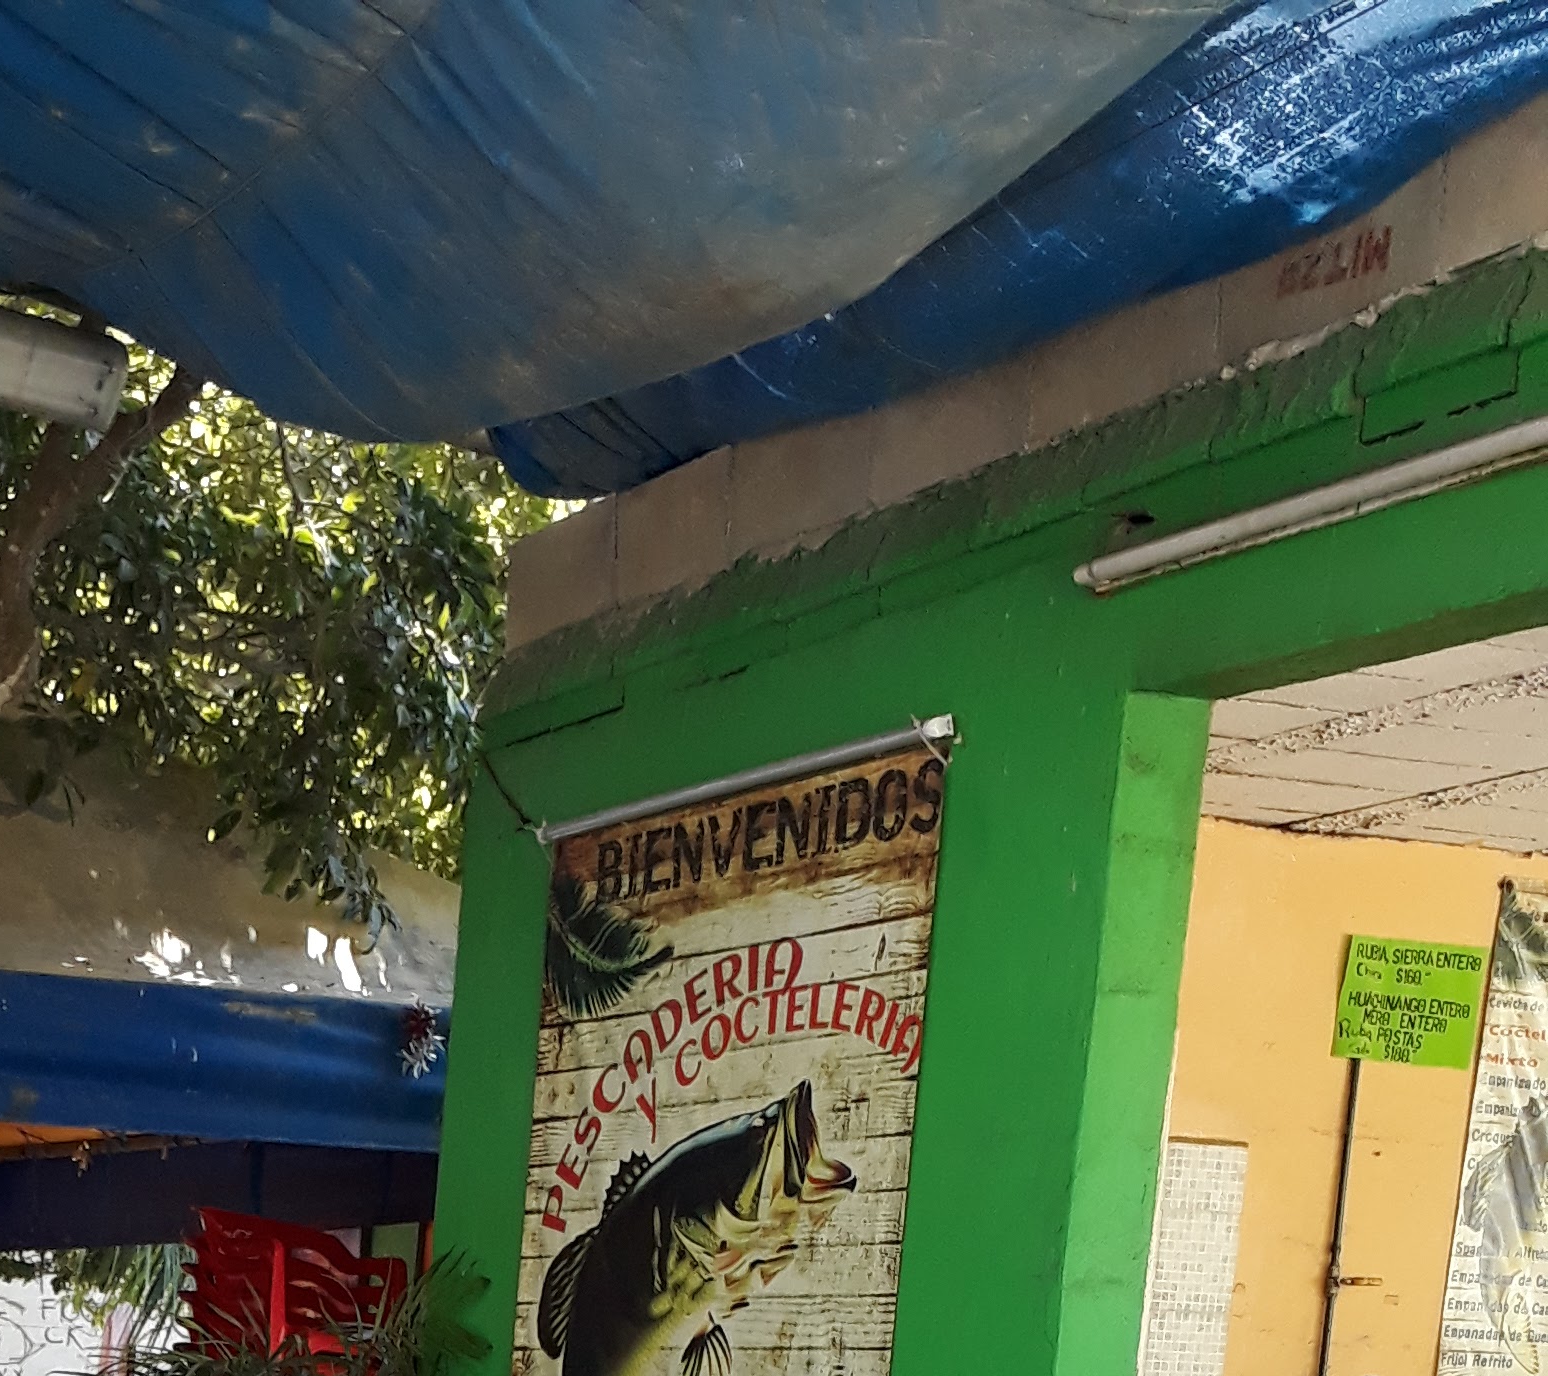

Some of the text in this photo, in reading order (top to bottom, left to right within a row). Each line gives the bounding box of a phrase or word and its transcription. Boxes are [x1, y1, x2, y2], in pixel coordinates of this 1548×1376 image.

[595, 759, 945, 902] BIENVENIDOS
[1392, 949, 1434, 966] SIERRA
[542, 937, 803, 1233] PESCADERIA
[636, 982, 924, 1143] Y COCTELERIA
